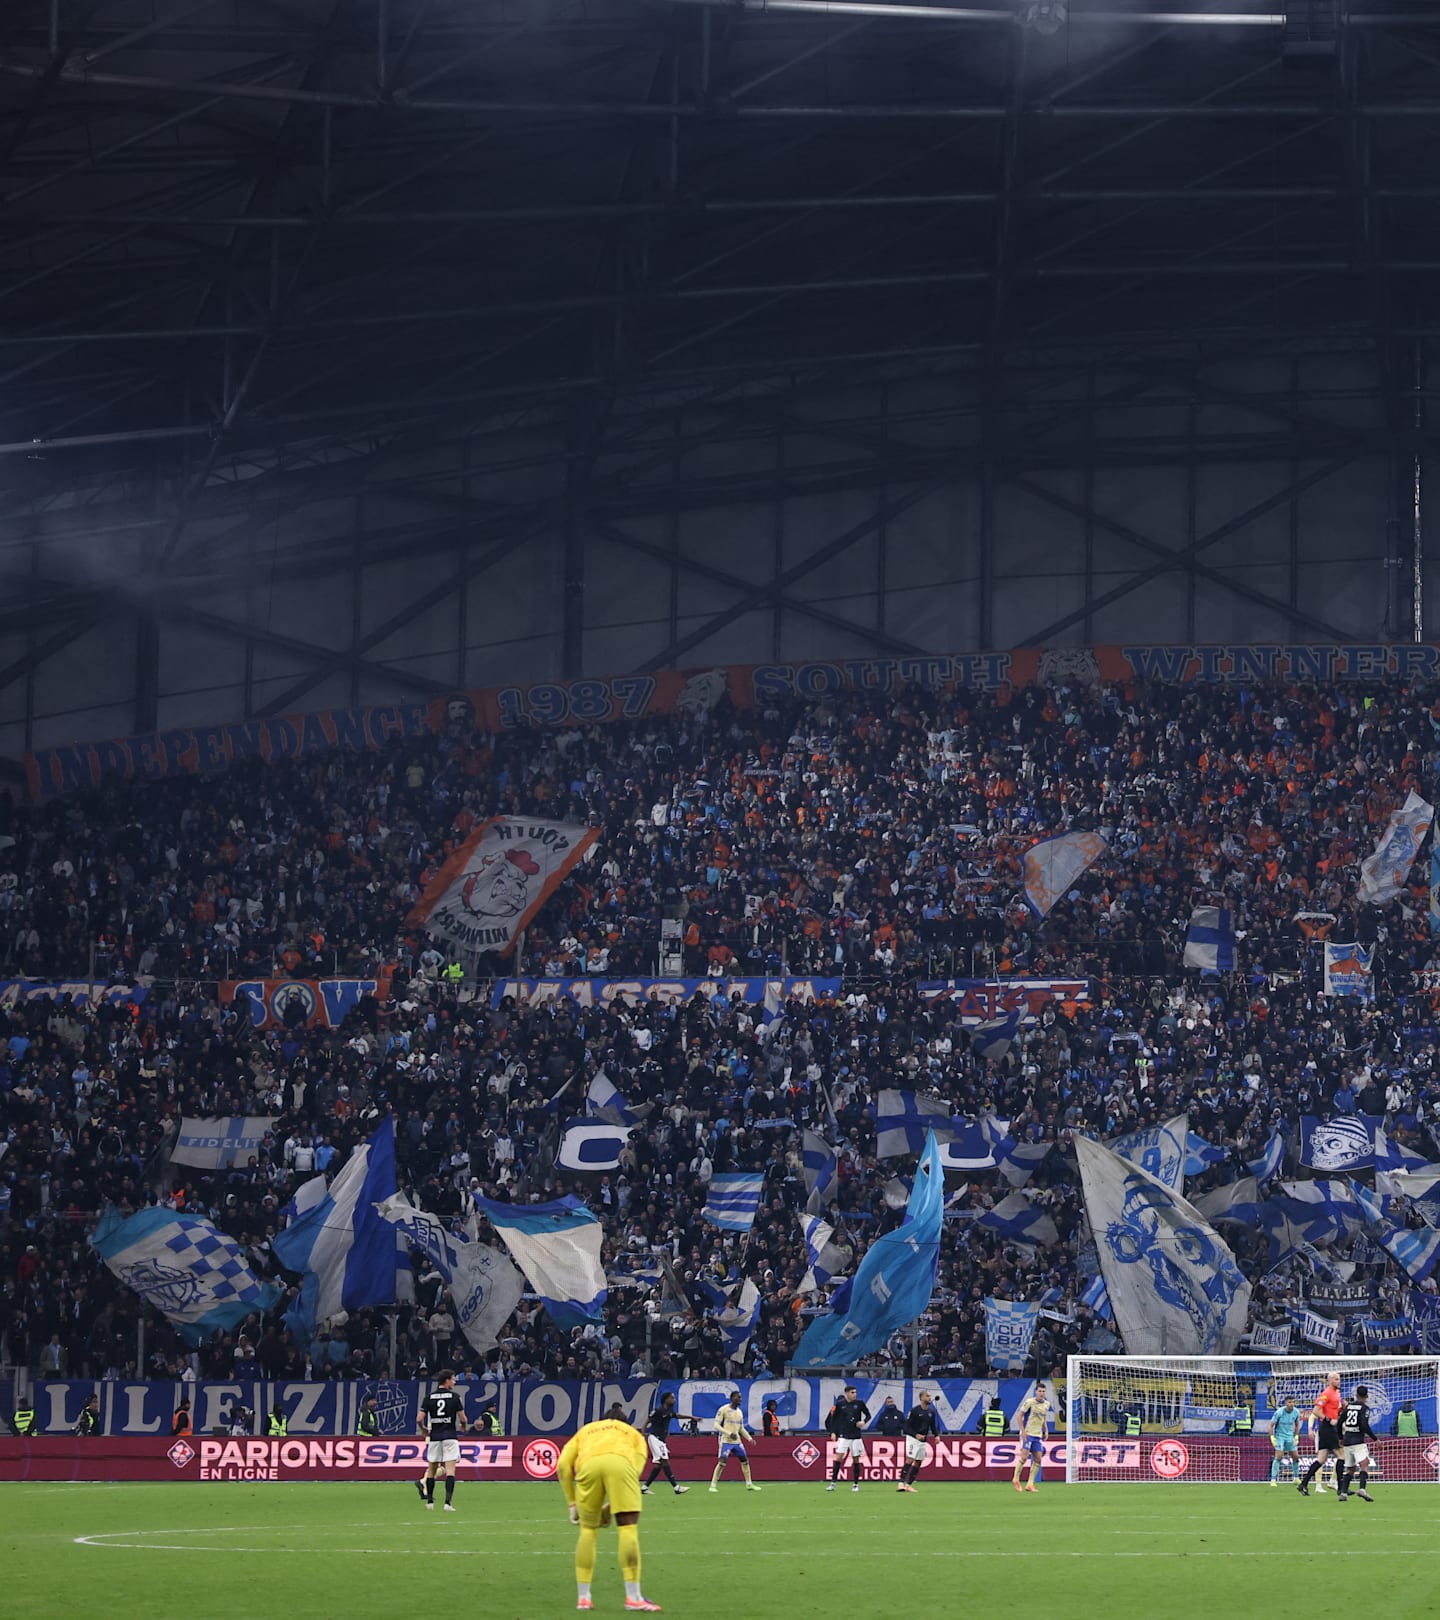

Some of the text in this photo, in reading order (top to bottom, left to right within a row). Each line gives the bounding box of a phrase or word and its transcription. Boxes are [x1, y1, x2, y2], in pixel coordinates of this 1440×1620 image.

[751, 653, 1012, 700] SOUTH
[498, 675, 657, 728] 1987
[33, 703, 434, 795] INDEPENDANCE
[187, 1137, 262, 1149] FIDELIT
[557, 1124, 636, 1170] C
[0, 1383, 327, 1432] LLEZ
[437, 1399, 446, 1416] 2
[1345, 1409, 1359, 1426] 23
[200, 1440, 355, 1468] PARIONS
[200, 1468, 279, 1480] EN LIGNE
[859, 1468, 903, 1481] IGNE
